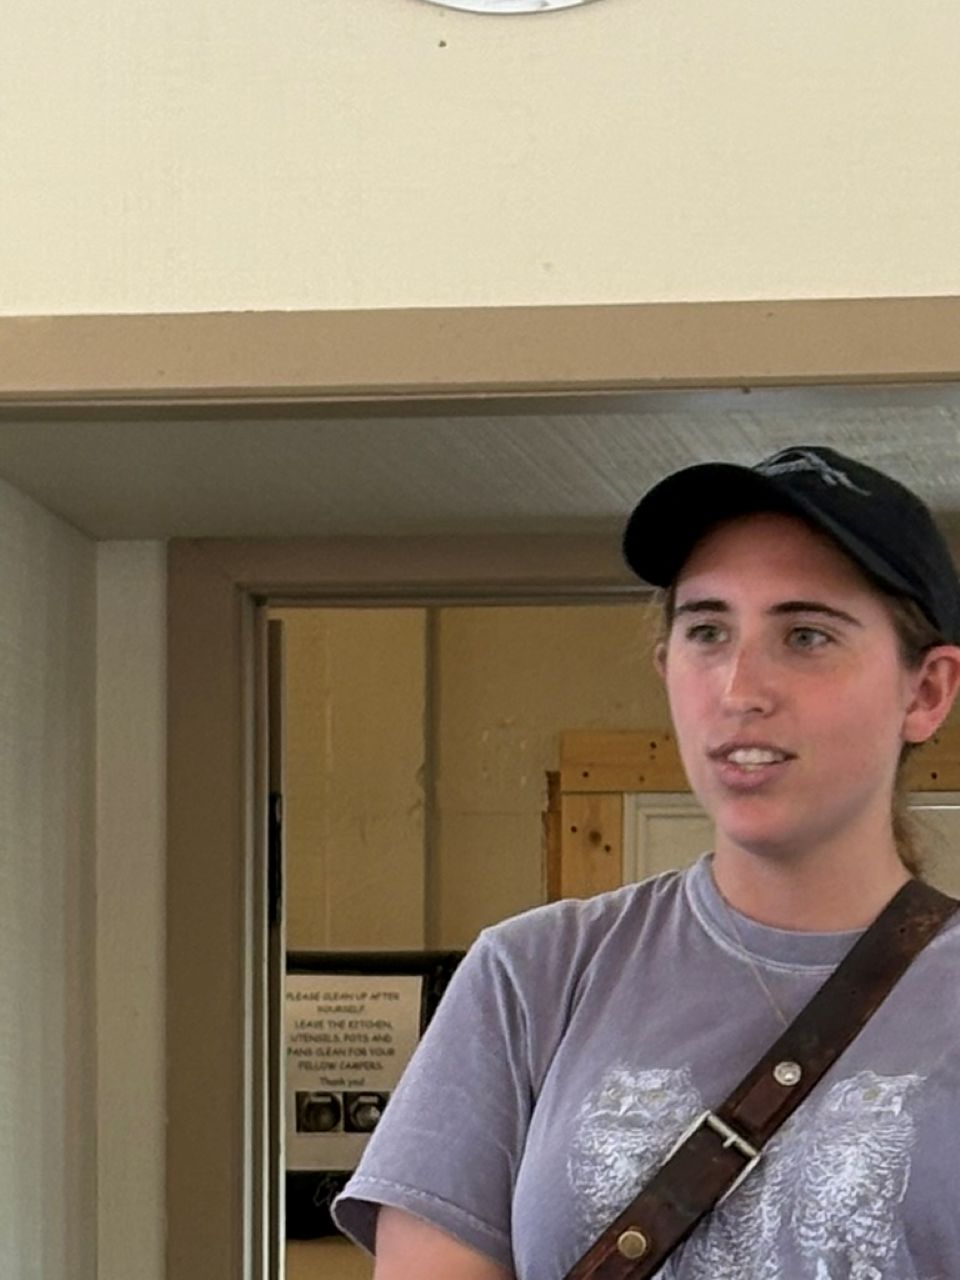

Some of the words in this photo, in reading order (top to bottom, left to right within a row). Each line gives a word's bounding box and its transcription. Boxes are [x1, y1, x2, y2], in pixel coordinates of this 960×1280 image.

[286, 992, 319, 1001] PLEASE
[370, 992, 399, 1001] AFTER
[295, 1020, 324, 1029] LEAVE
[327, 1020, 345, 1029] THE
